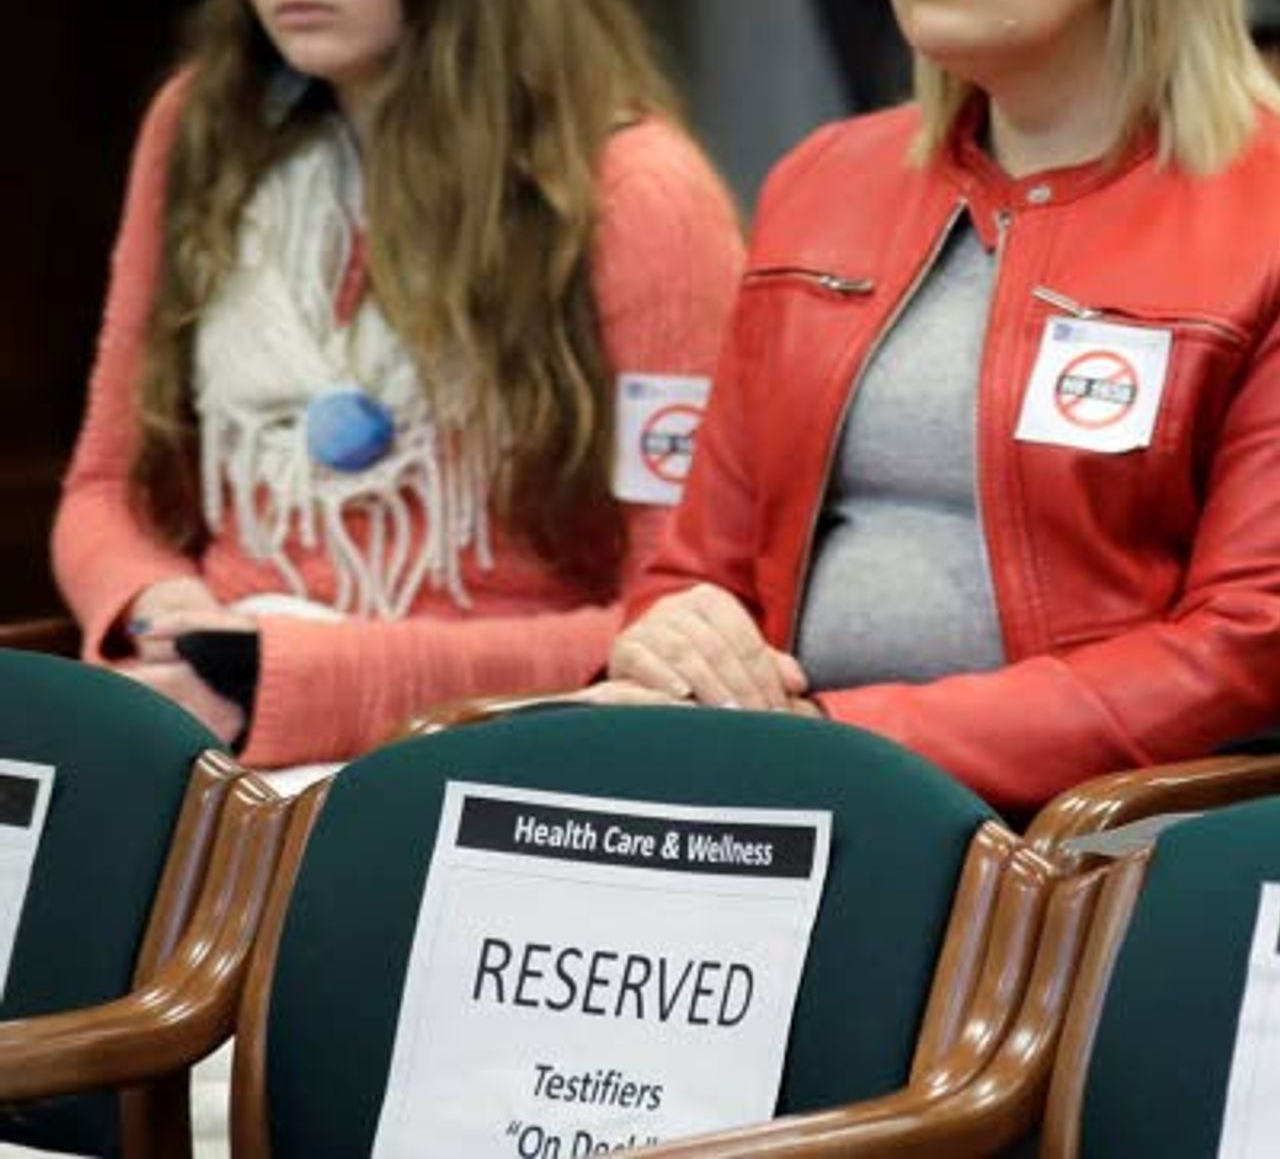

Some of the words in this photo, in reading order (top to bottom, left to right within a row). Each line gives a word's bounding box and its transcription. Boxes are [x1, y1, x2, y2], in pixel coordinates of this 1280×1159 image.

[514, 815, 596, 852] Health
[603, 826, 654, 857] Care
[661, 832, 680, 860] &
[687, 835, 774, 867] Wellness
[473, 938, 754, 1026] RESERVED
[533, 1063, 664, 1112] Testifiers
